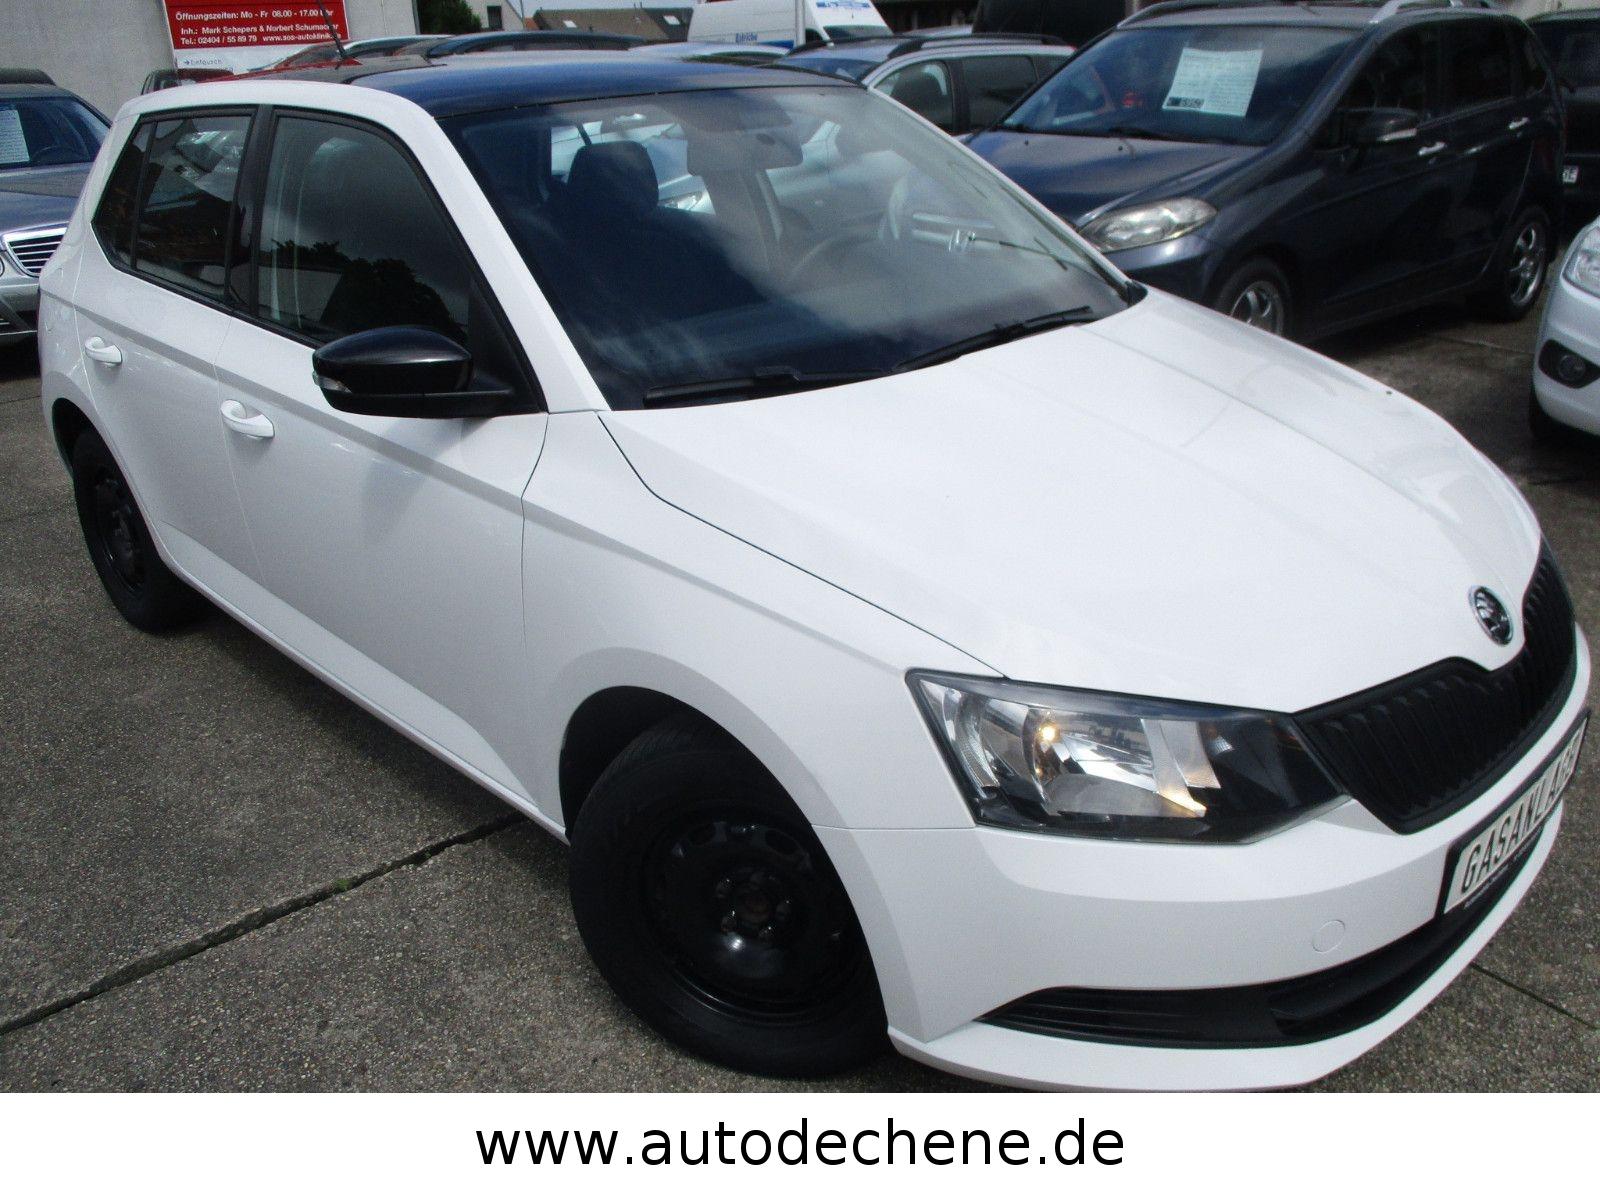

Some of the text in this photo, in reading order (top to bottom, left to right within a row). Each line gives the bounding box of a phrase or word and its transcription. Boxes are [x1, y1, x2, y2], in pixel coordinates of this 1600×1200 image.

[176, 10, 239, 21] Öffnungszeiten:
[240, 11, 253, 19] Mo
[260, 10, 269, 18] Fr
[271, 9, 292, 18] 08.00
[299, 9, 319, 18] 17.00
[181, 27, 198, 35] Inh.:
[201, 26, 221, 35] Mark
[223, 26, 258, 34] Schepers
[266, 24, 294, 32] Norbert
[295, 23, 339, 31] Schumacer
[180, 37, 197, 45] Tel.:
[197, 36, 220, 44] 02404
[262, 32, 342, 41] www.sos-autoklinik.e
